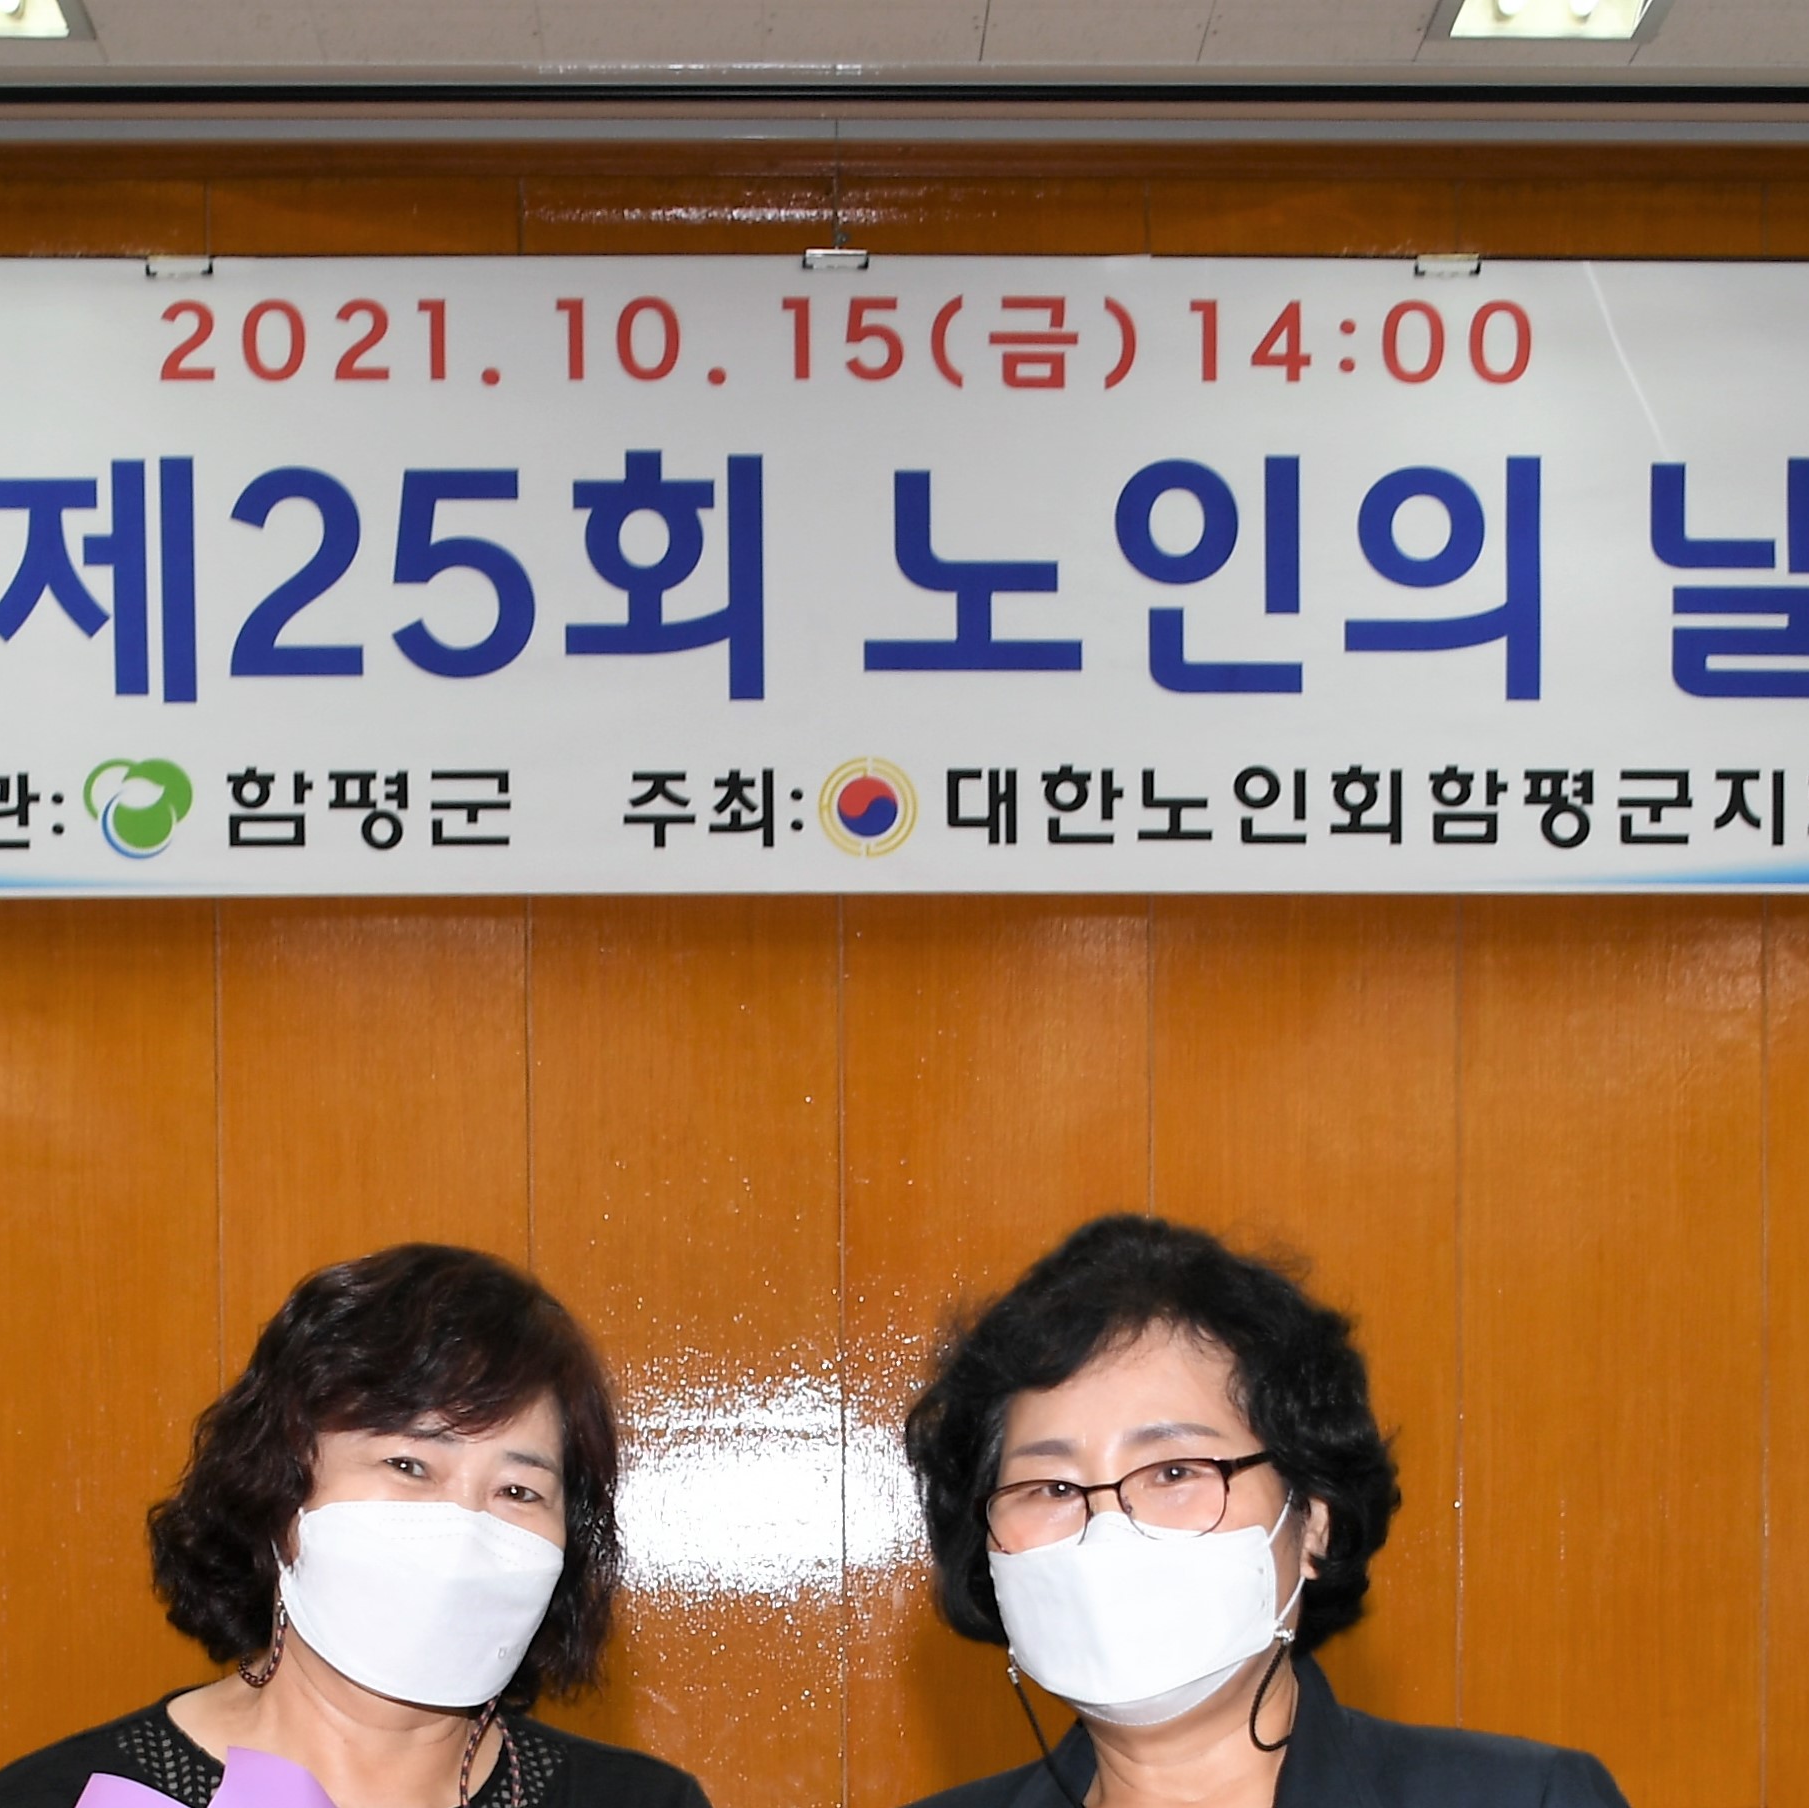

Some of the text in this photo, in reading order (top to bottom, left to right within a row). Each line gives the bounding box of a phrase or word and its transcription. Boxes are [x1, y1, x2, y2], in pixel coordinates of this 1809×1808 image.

[1190, 299, 1531, 384] 14:00
[864, 456, 1541, 700] 노인의
[227, 767, 511, 850] 함평군
[624, 769, 803, 848] 주최:
